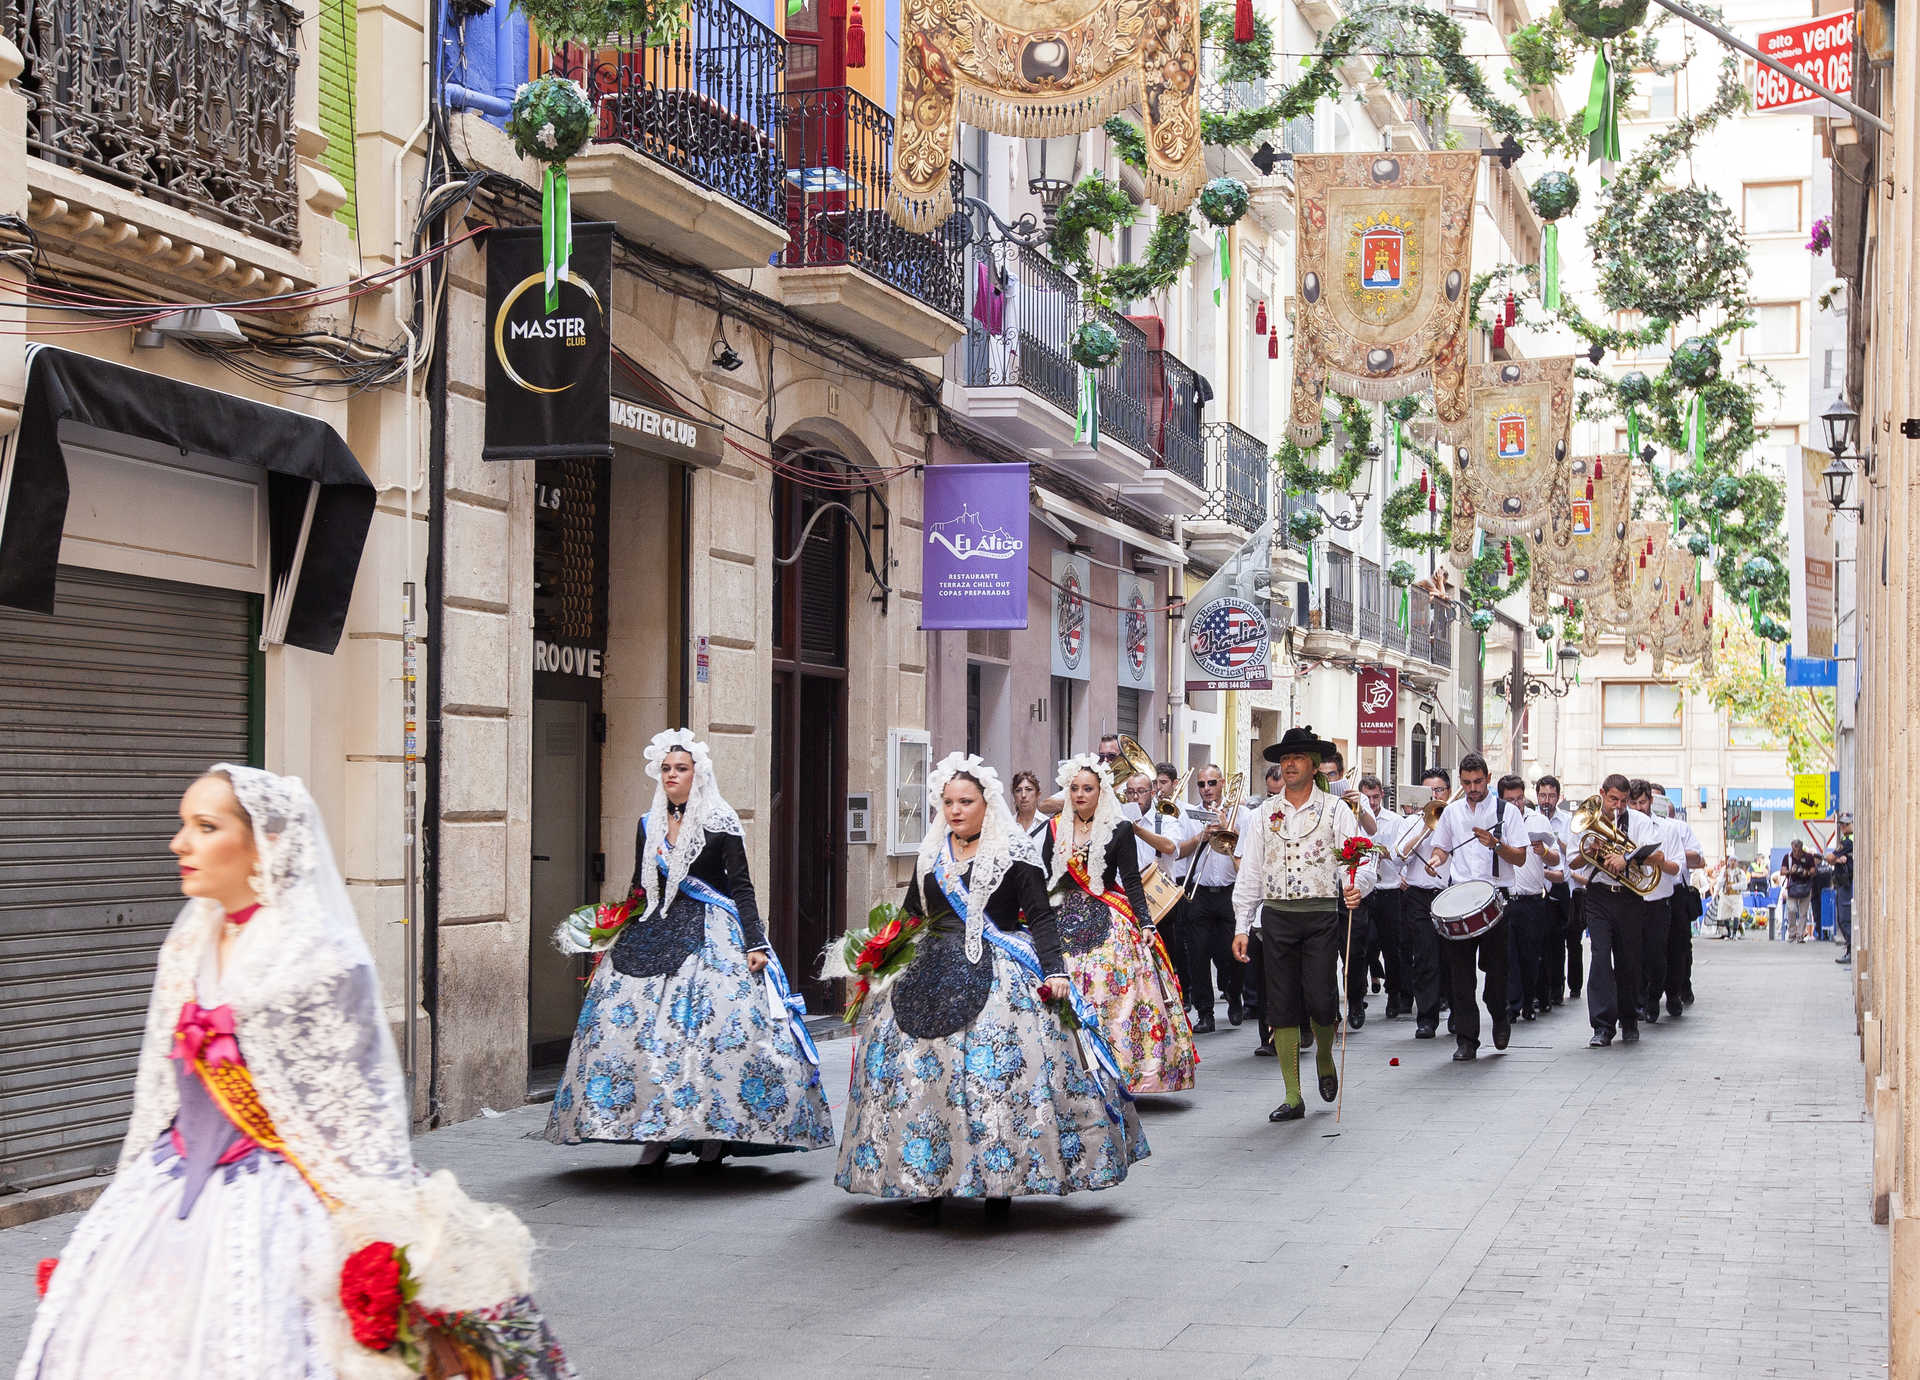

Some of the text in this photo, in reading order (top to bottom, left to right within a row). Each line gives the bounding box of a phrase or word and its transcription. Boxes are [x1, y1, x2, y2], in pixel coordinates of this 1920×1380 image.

[1758, 69, 1789, 107] 965
[511, 318, 586, 339] MASTER
[565, 337, 587, 347] CLUB
[662, 418, 697, 448] CLUB
[1191, 615, 1204, 636] The
[1199, 601, 1223, 617] Best
[534, 640, 602, 678] ROOVE
[1248, 640, 1267, 665] Diner
[1246, 670, 1265, 680] OPEN
